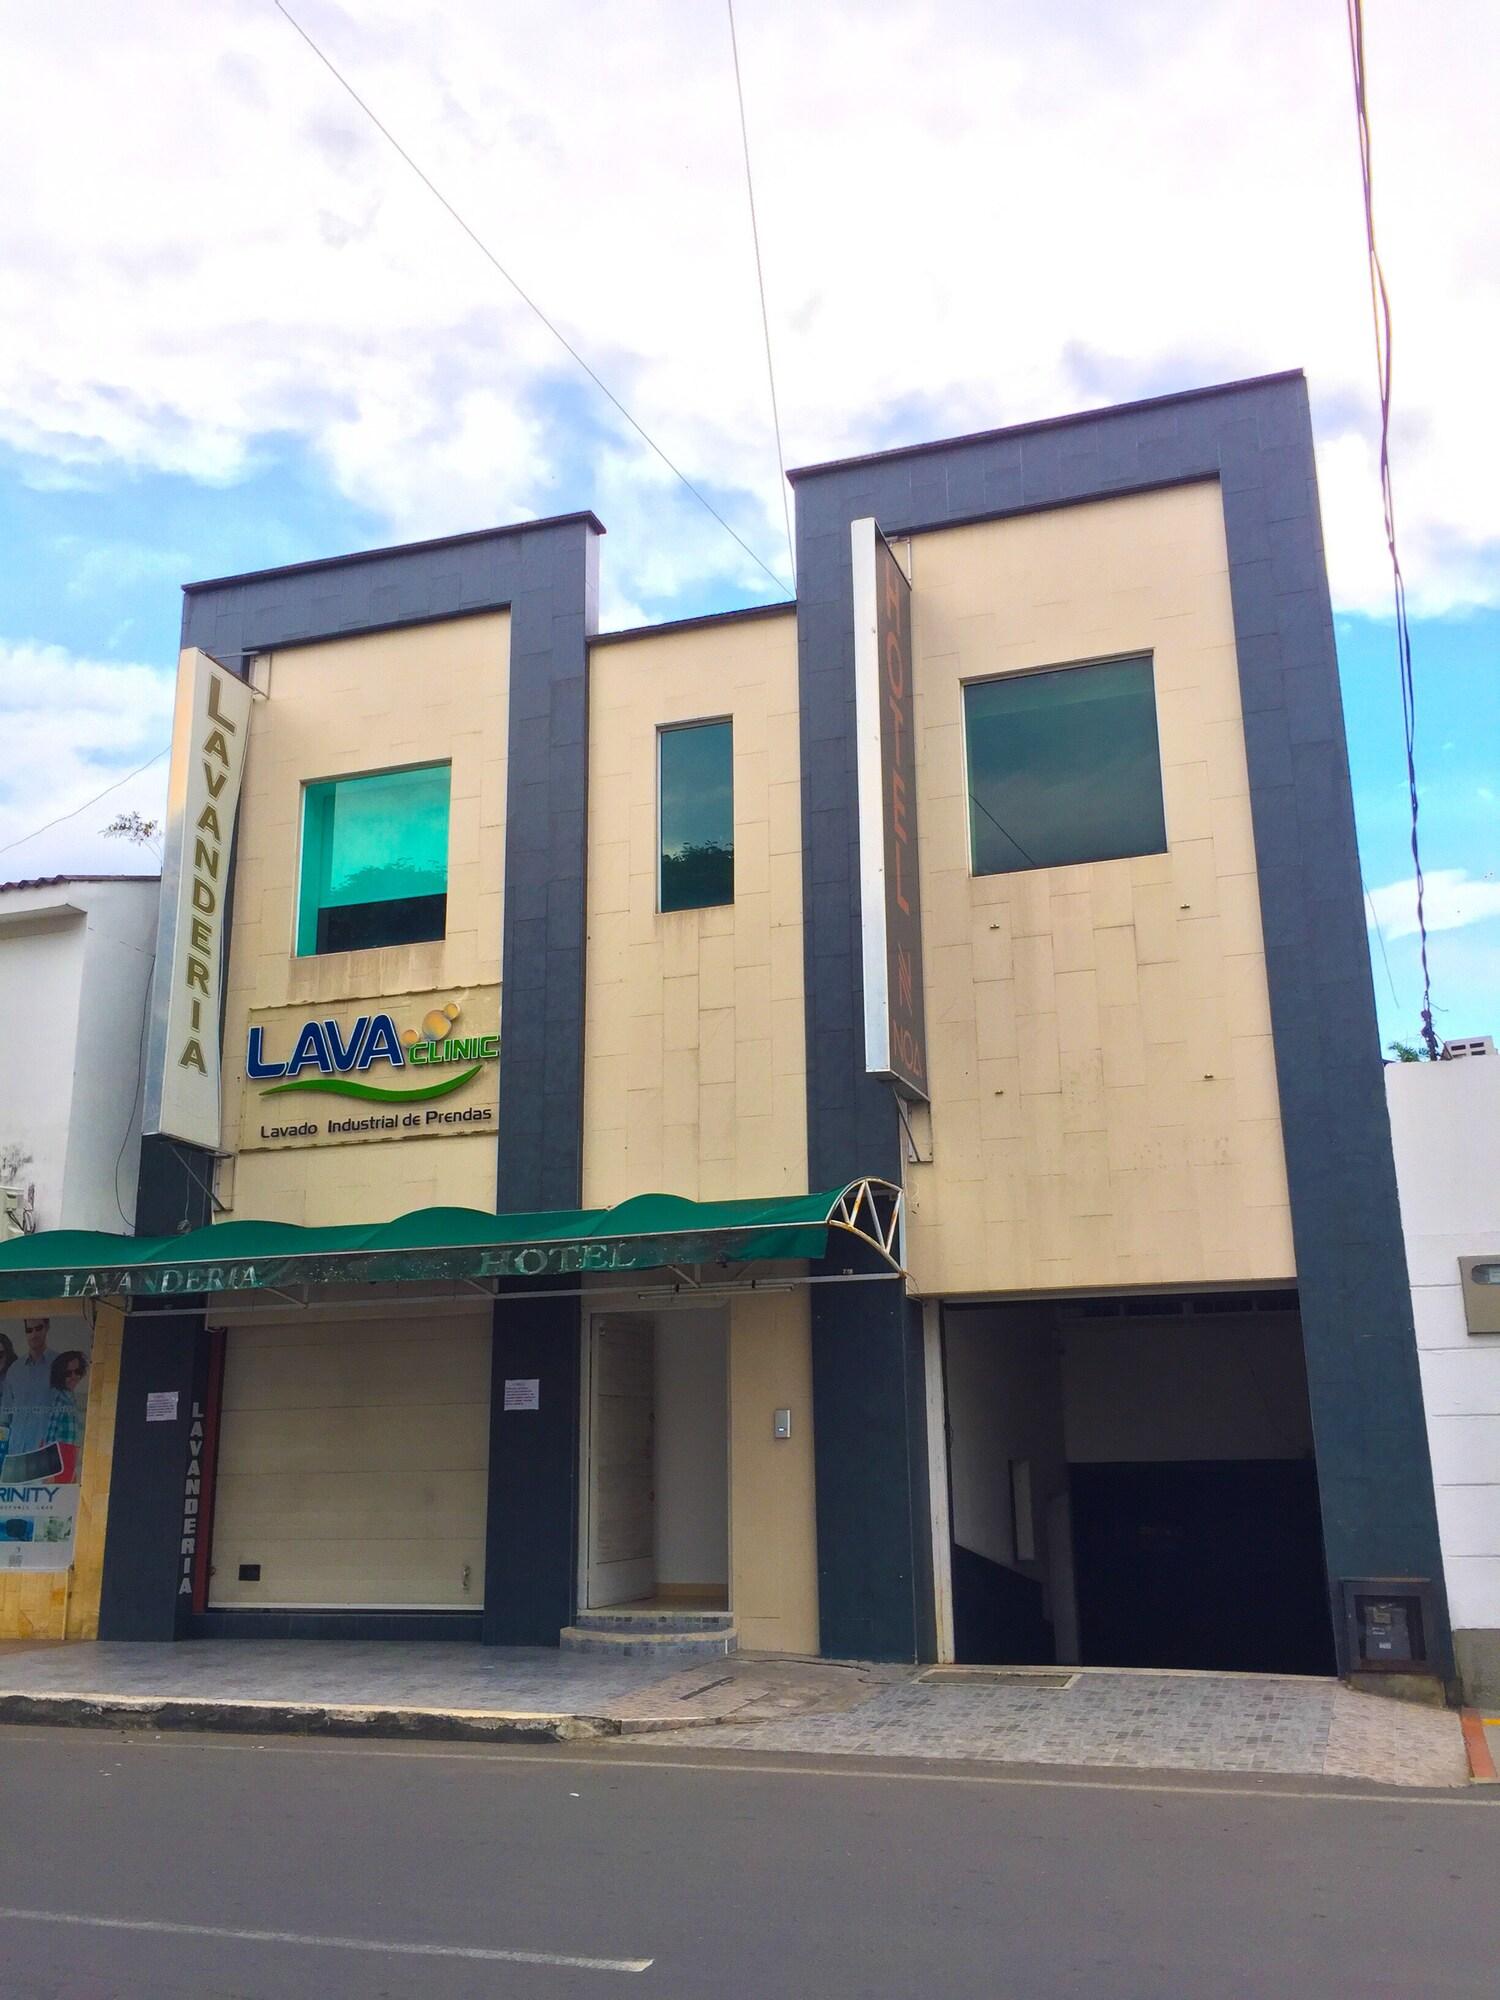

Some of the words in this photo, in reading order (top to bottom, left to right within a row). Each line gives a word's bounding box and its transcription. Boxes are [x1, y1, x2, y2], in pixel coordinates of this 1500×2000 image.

[885, 557, 910, 916] HOTEL
[178, 671, 236, 1077] LAVANDERIA
[246, 1013, 404, 1079] LAVA
[408, 1035, 500, 1065] CLINIC
[260, 1122, 318, 1139] Lavado
[327, 1115, 399, 1133] Industrial
[402, 1112, 421, 1127] de
[425, 1107, 492, 1125] Prendas
[61, 1265, 258, 1298] LAVANDERIA
[478, 1242, 637, 1277] HOTEL
[178, 1401, 204, 1595] LAVANDERIA
